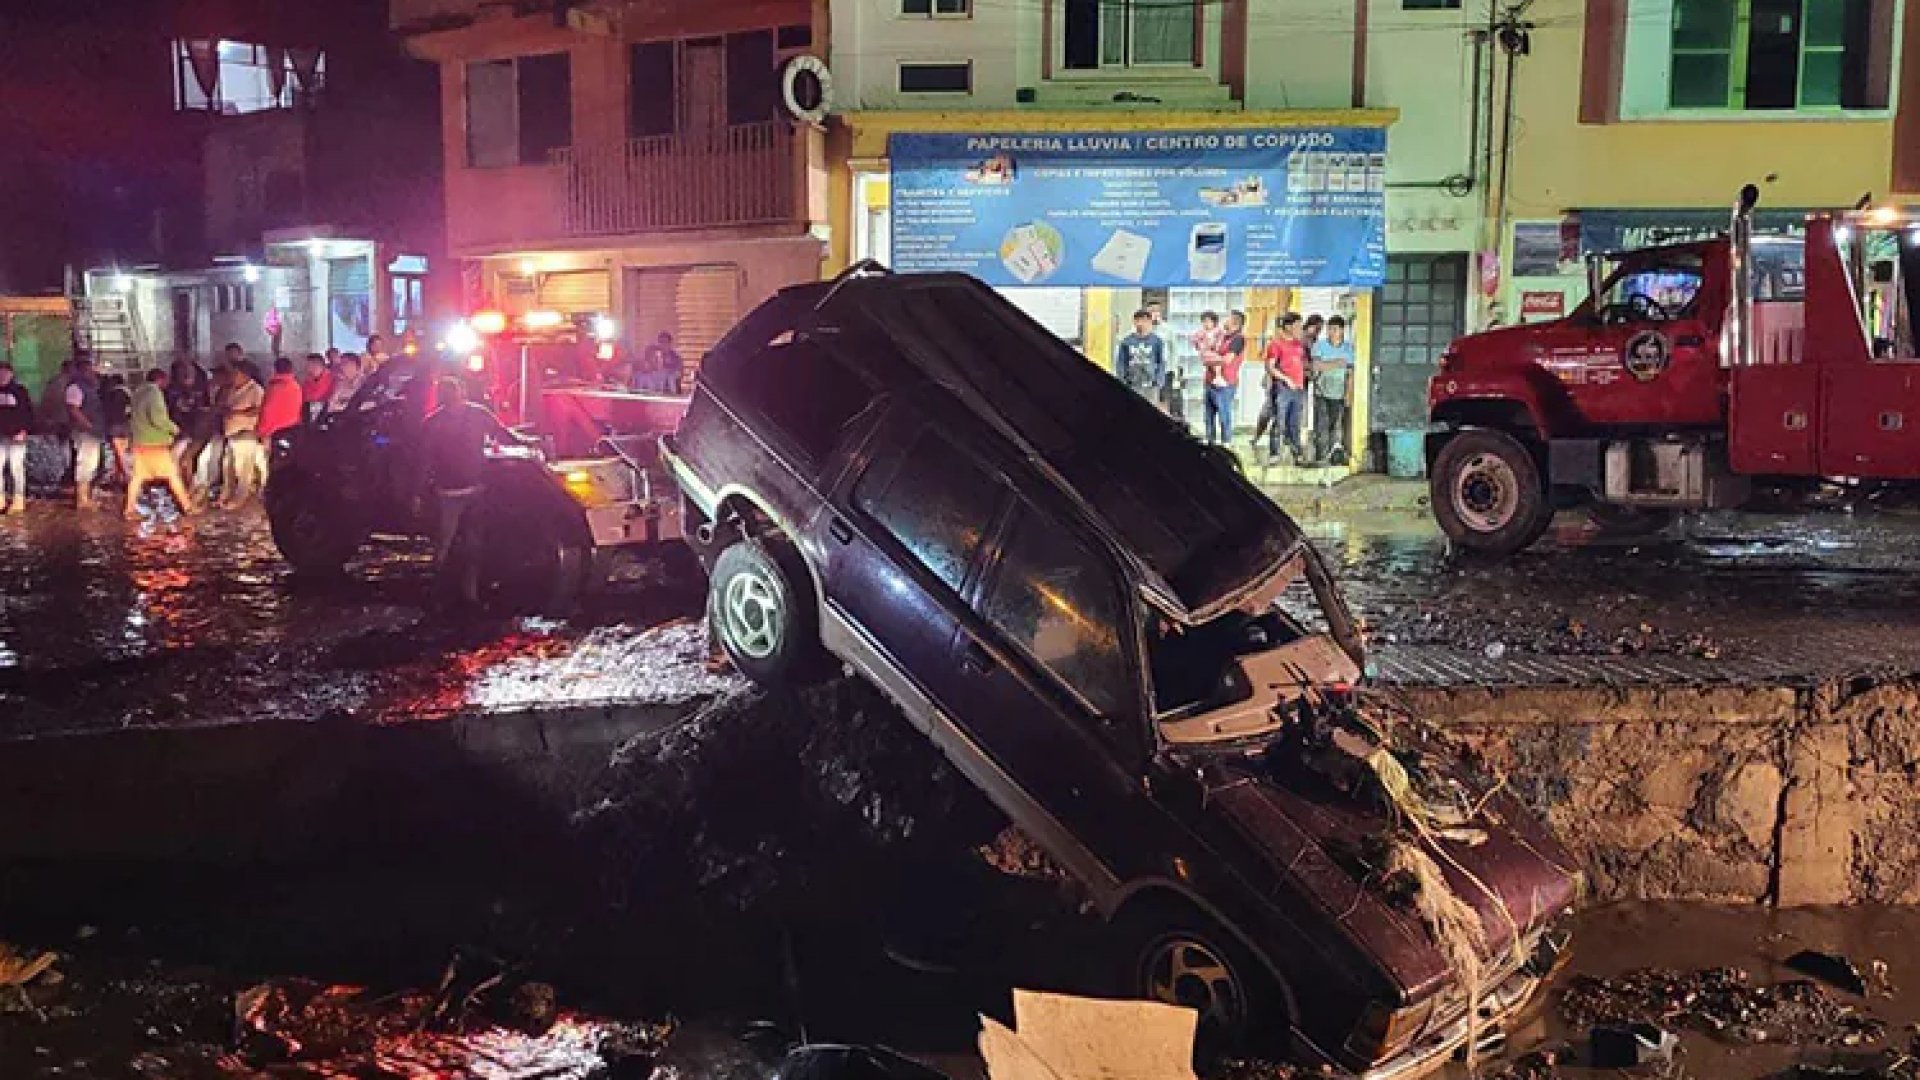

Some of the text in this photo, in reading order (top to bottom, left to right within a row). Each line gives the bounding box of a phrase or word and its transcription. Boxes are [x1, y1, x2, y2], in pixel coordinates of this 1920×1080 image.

[967, 137, 1063, 150] PAPELERIA
[1067, 137, 1132, 150] LLUVIA
[1146, 134, 1220, 149] CENTRO
[1224, 134, 1248, 149] DE
[1253, 132, 1335, 147] COPIADO
